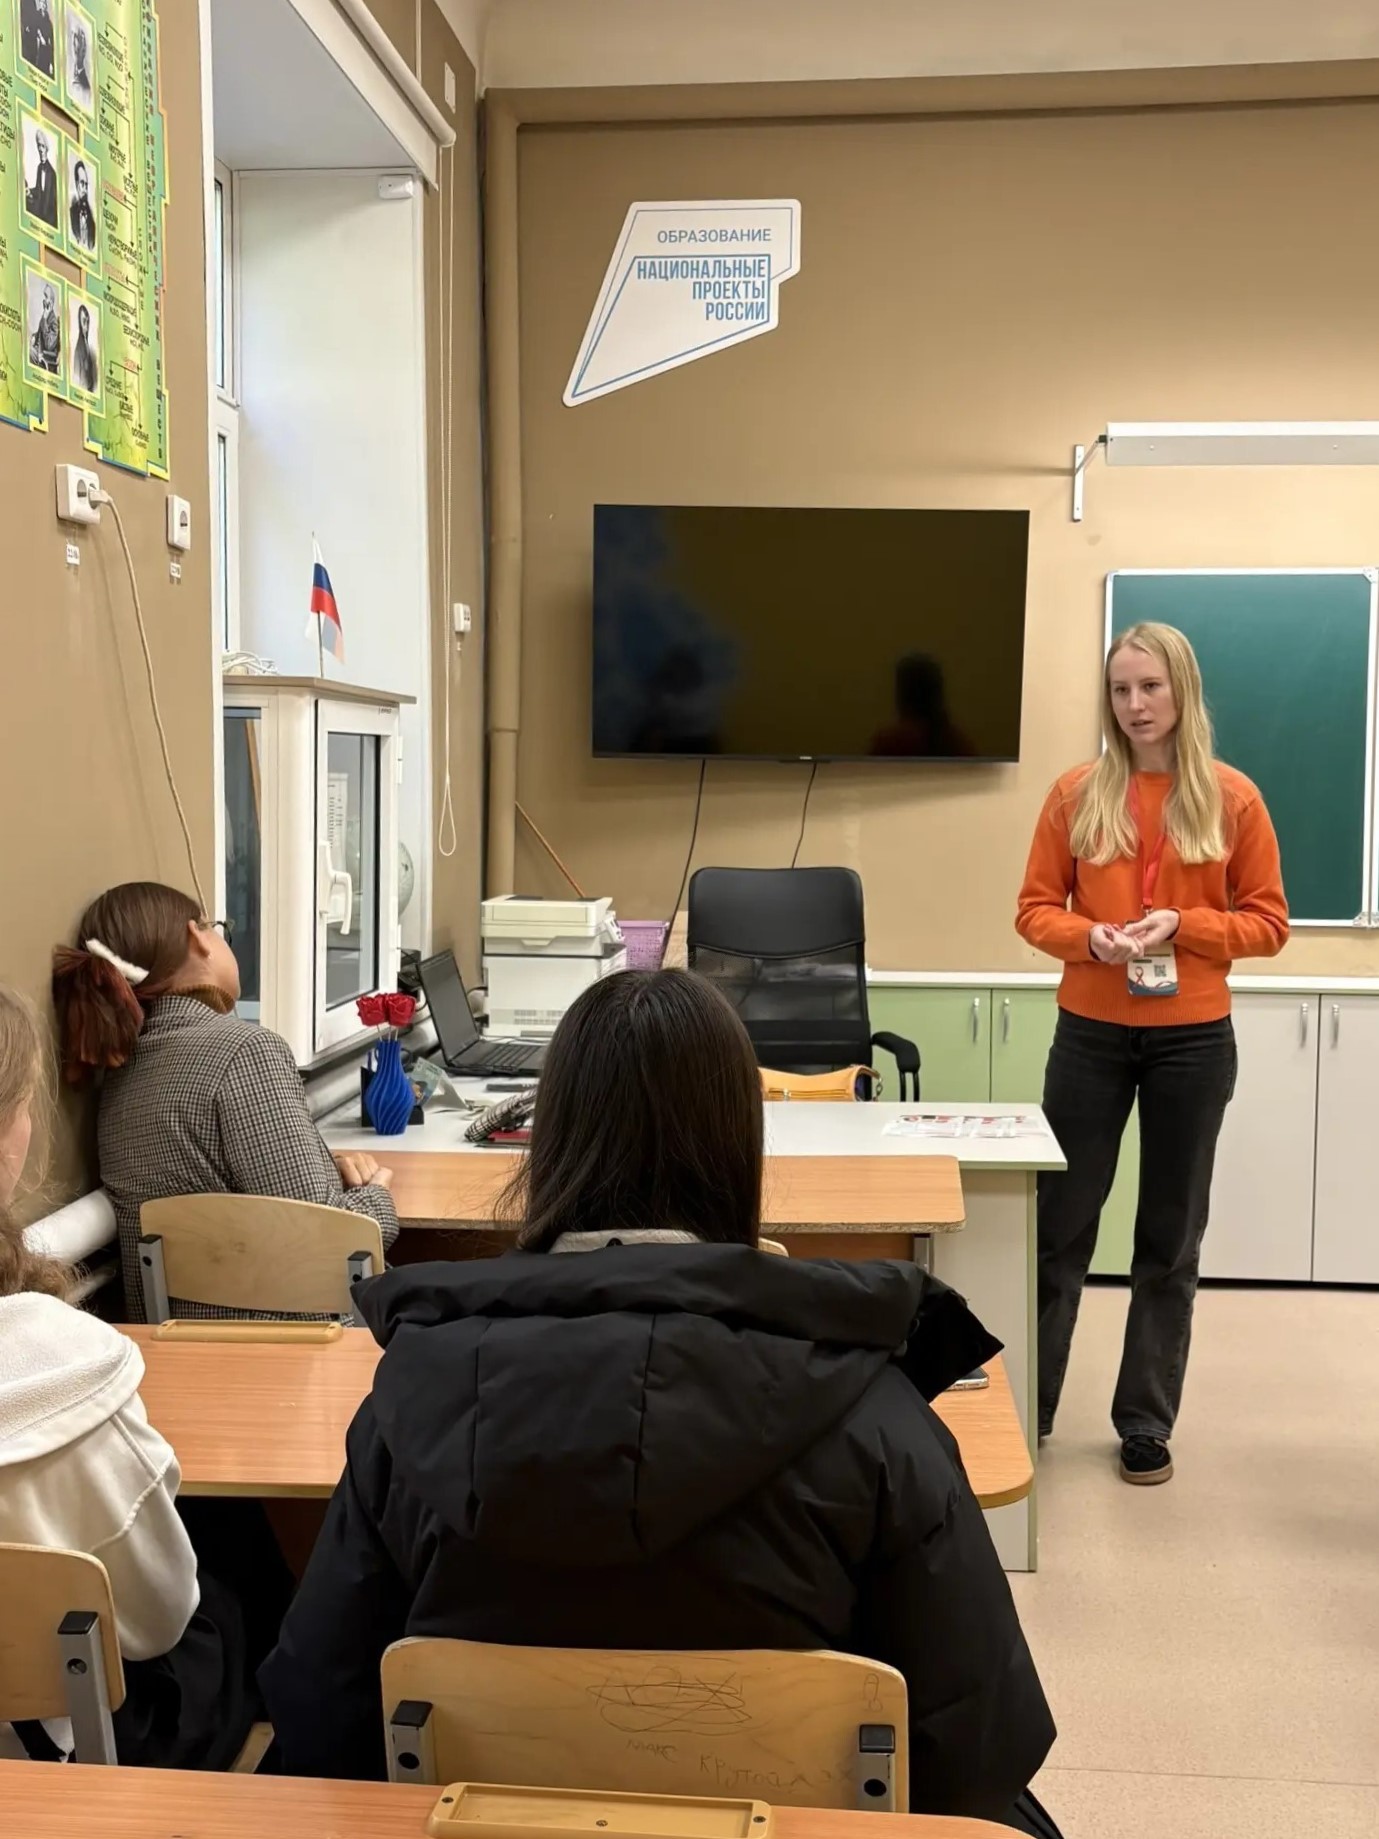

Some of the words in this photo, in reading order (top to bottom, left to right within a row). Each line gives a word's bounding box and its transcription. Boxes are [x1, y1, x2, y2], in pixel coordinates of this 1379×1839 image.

[657, 228, 772, 244] ОБРАЗОВАНИЕ
[637, 259, 766, 281] НАЦИОНАЛЬНЫЕ
[692, 280, 765, 300] ПРОЕКТЫ
[705, 301, 765, 320] РОССИИ
